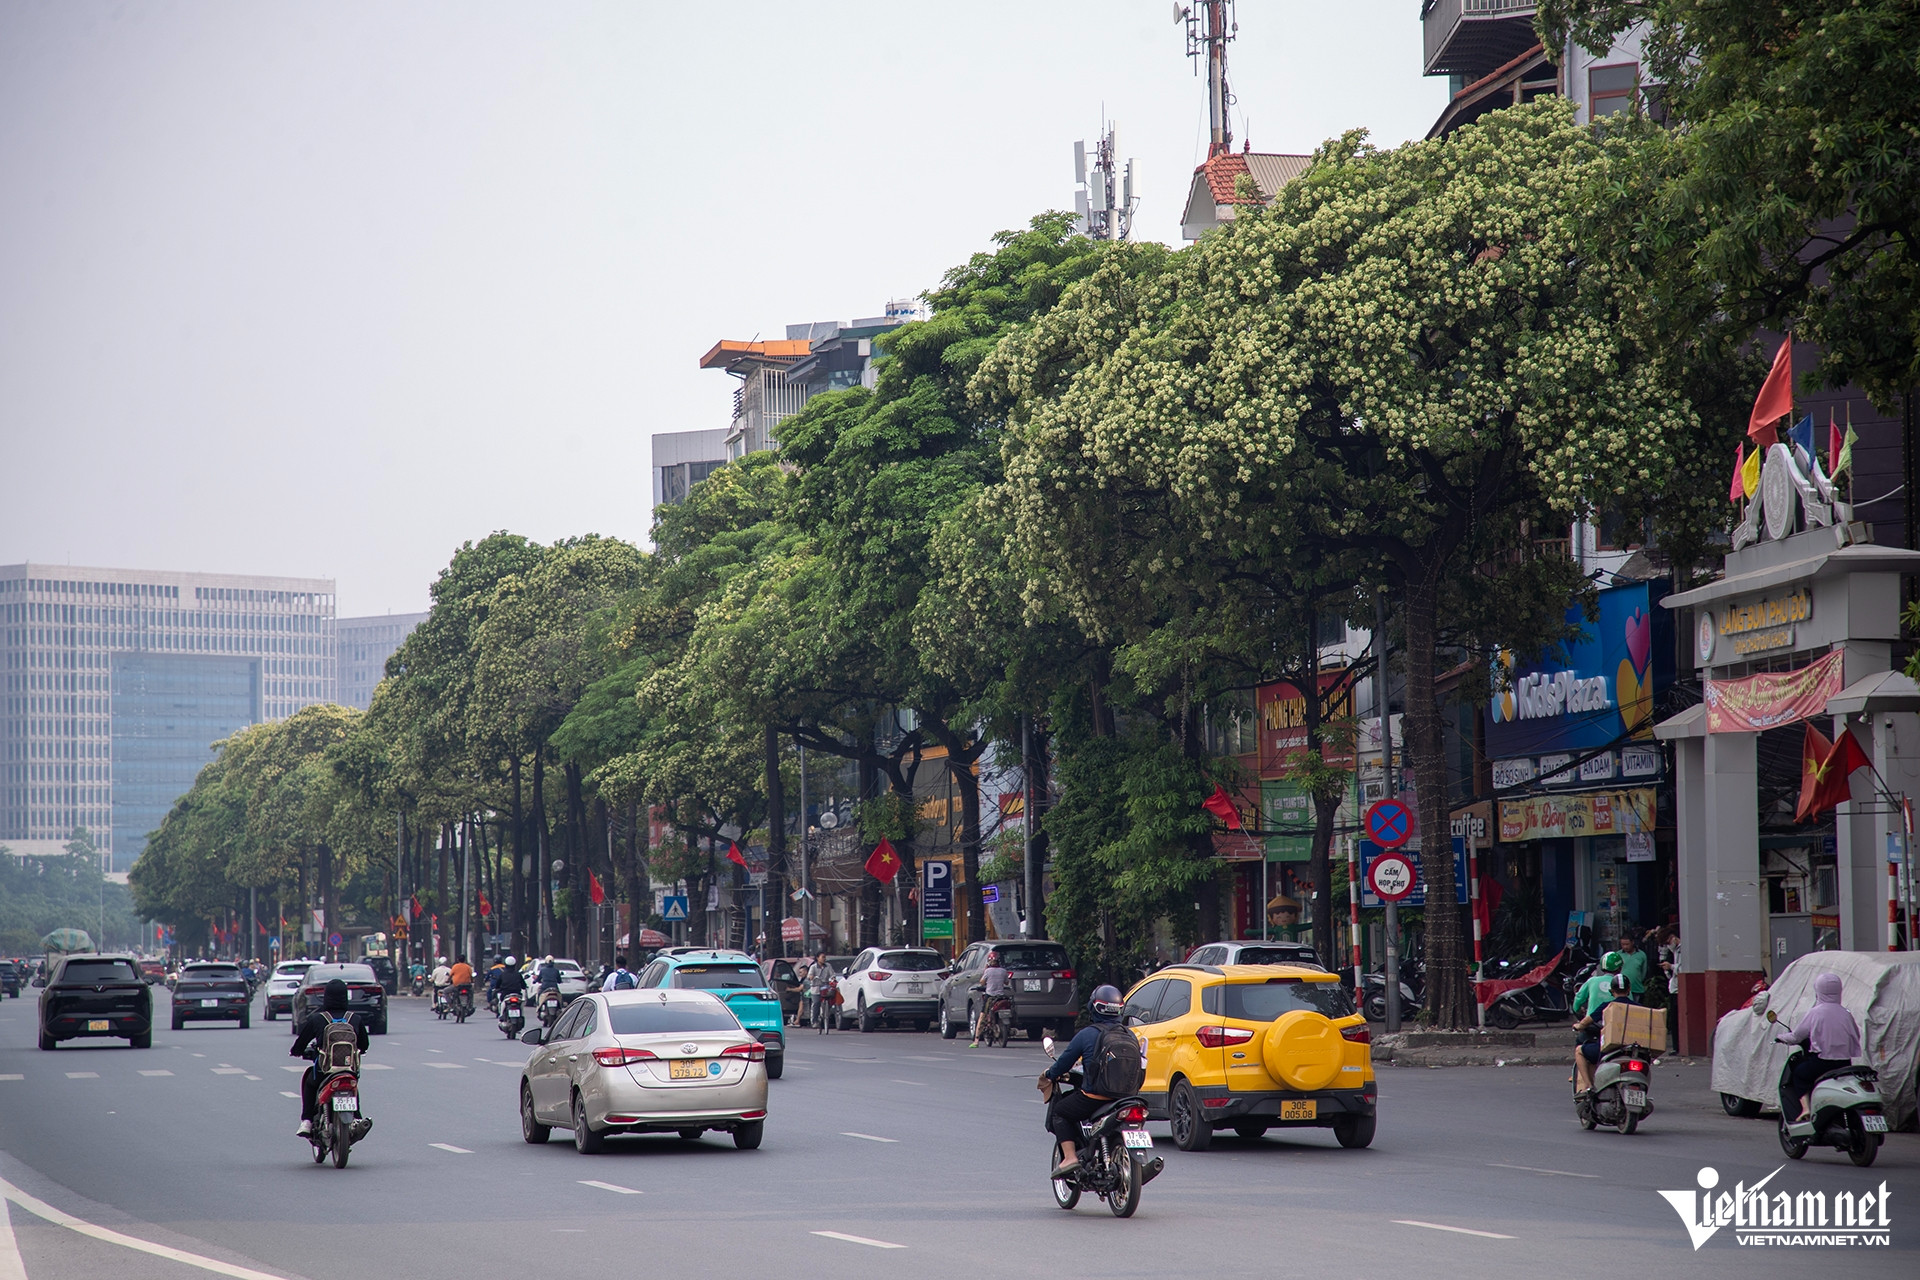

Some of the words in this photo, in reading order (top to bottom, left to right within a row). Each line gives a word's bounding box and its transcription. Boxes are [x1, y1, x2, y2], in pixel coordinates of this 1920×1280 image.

[1625, 753, 1654, 770] VITAMIN
[1450, 813, 1484, 837] coffee
[927, 863, 948, 888] P
[1384, 866, 1398, 876] CẤM
[680, 1060, 695, 1068] 30F
[674, 1069, 704, 1077] 379.72
[1292, 1101, 1307, 1110] 30E
[1285, 1111, 1313, 1119] 005.08
